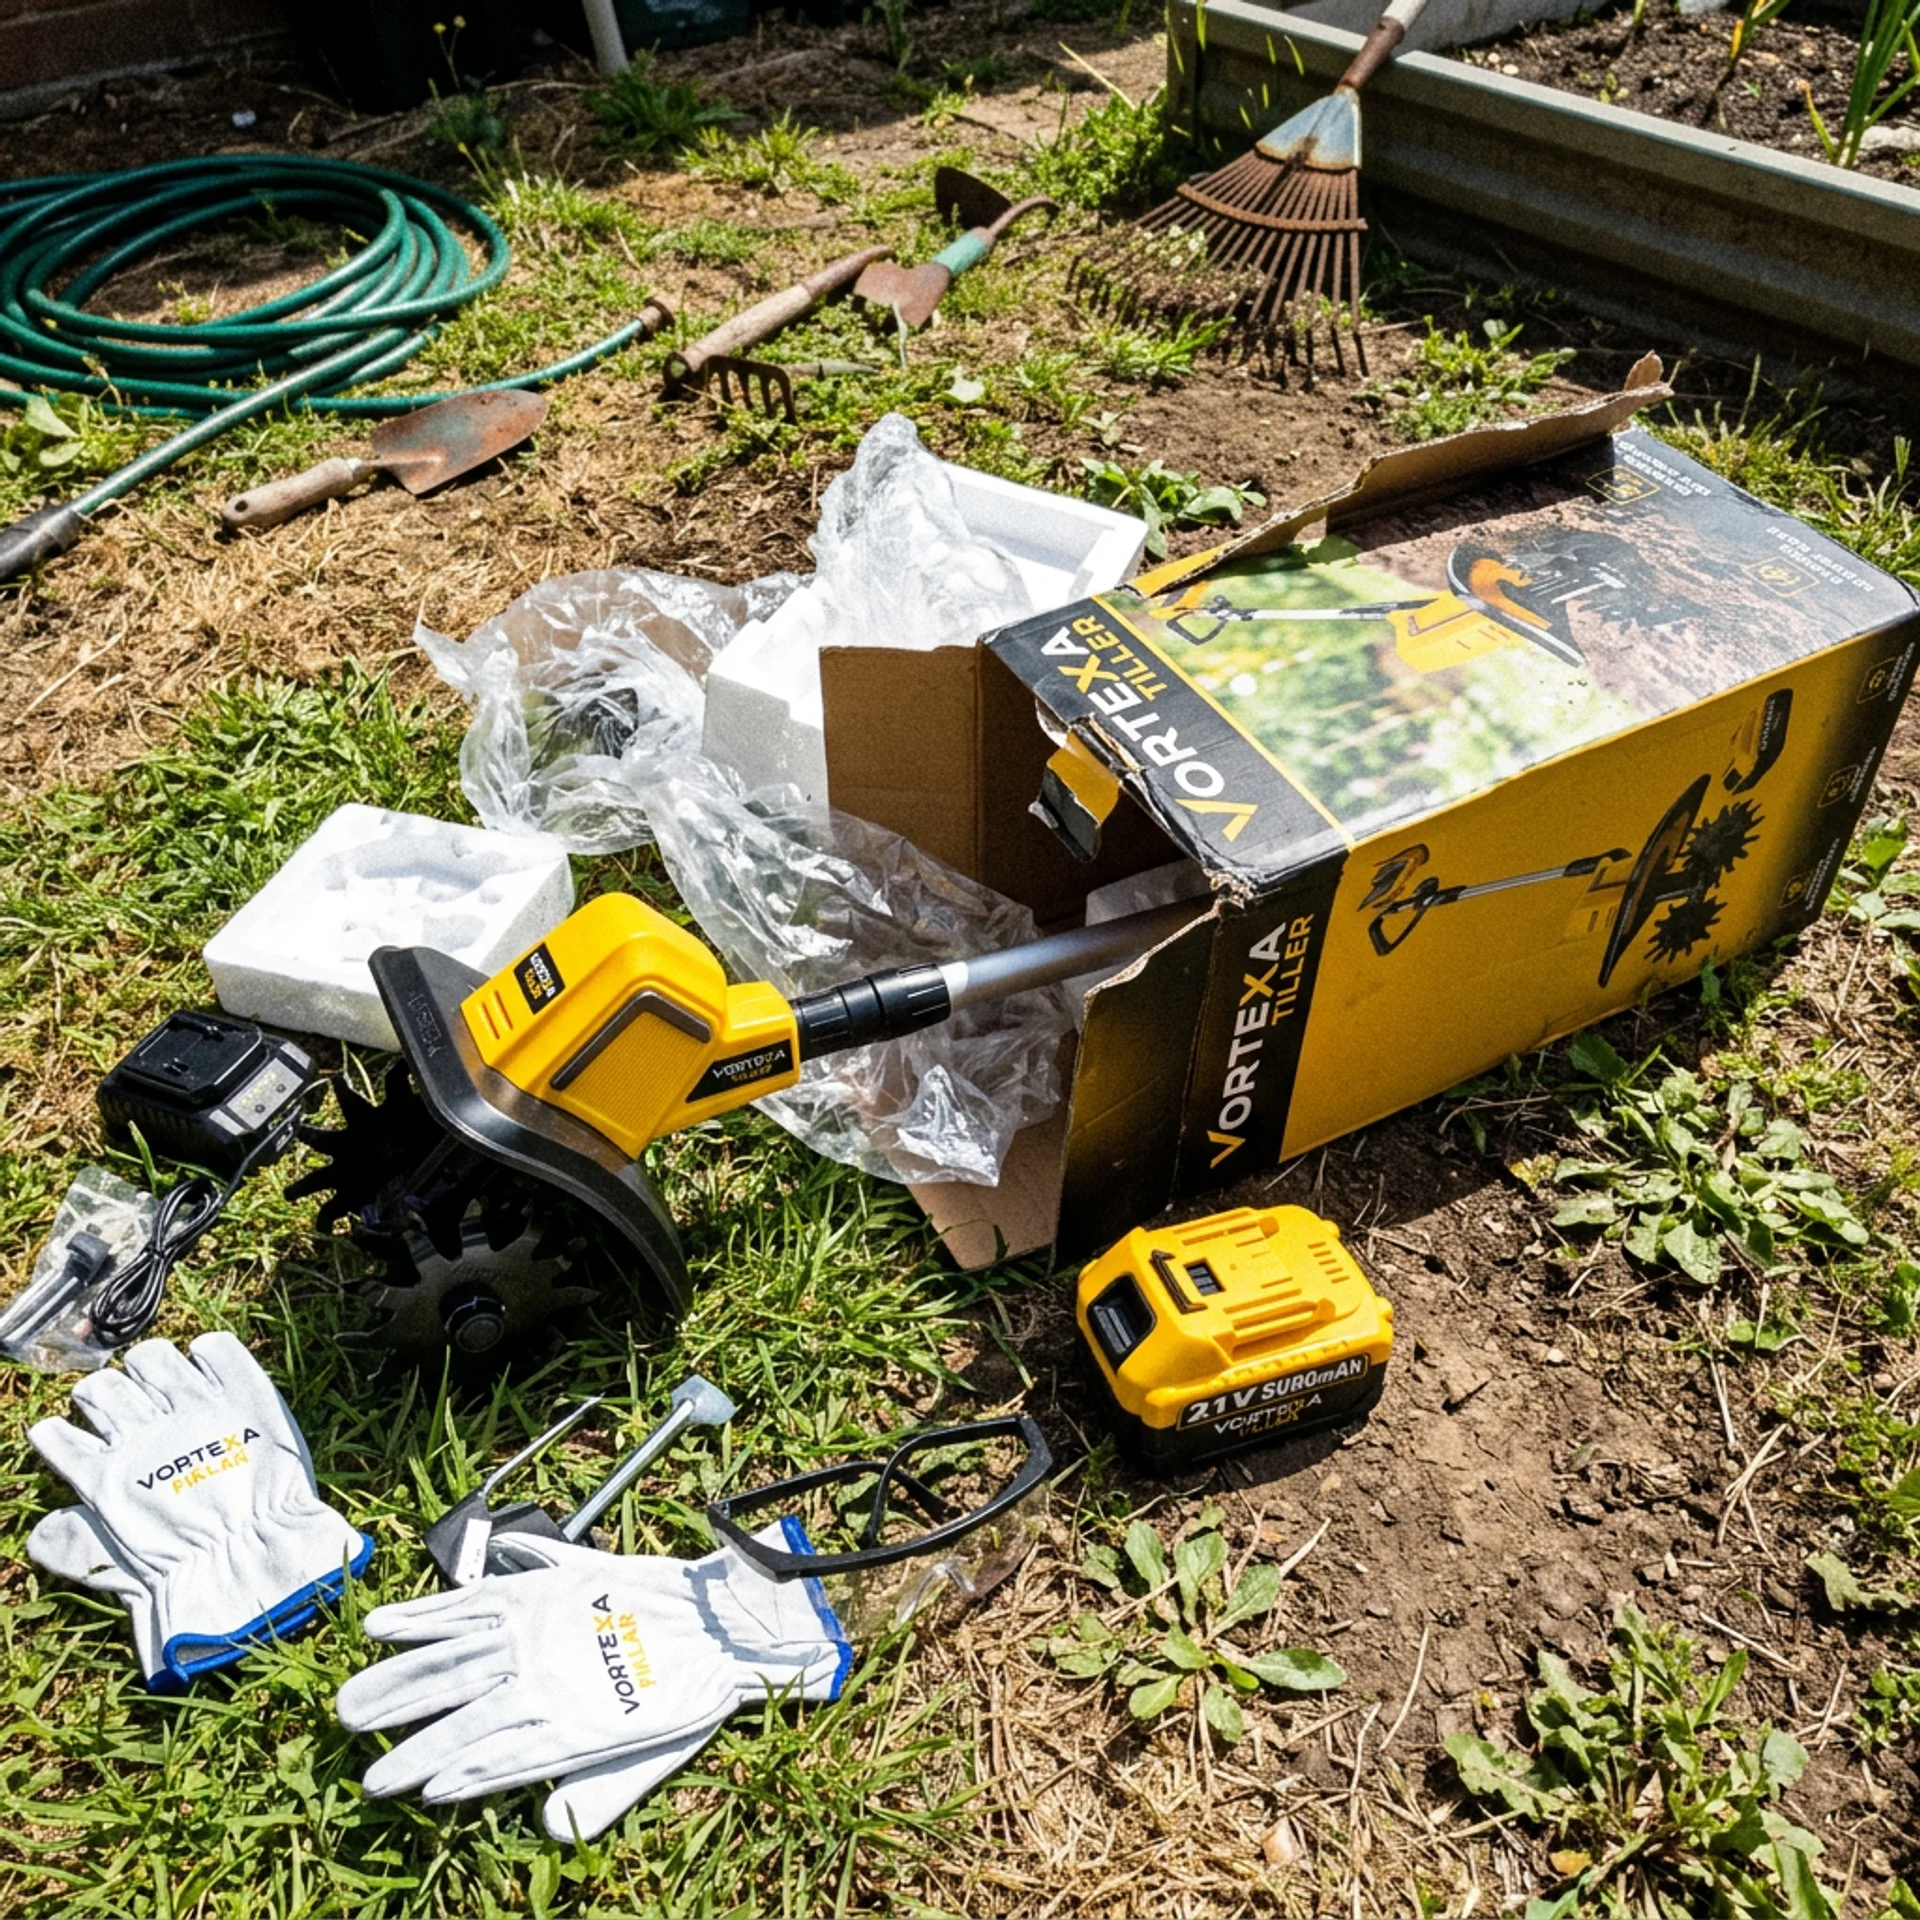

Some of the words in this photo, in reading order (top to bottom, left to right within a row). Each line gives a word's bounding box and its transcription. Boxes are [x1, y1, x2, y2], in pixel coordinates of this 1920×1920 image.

[1071, 614, 1168, 702] TILLER
[1040, 626, 1259, 843] VORTEXA
[1271, 913, 1315, 1027] TILLER
[1207, 922, 1287, 1169] VORTEXA
[136, 1427, 261, 1490] VORTEXA
[1187, 1386, 1258, 1423] 21V
[591, 1593, 641, 1715] VORTEXA
